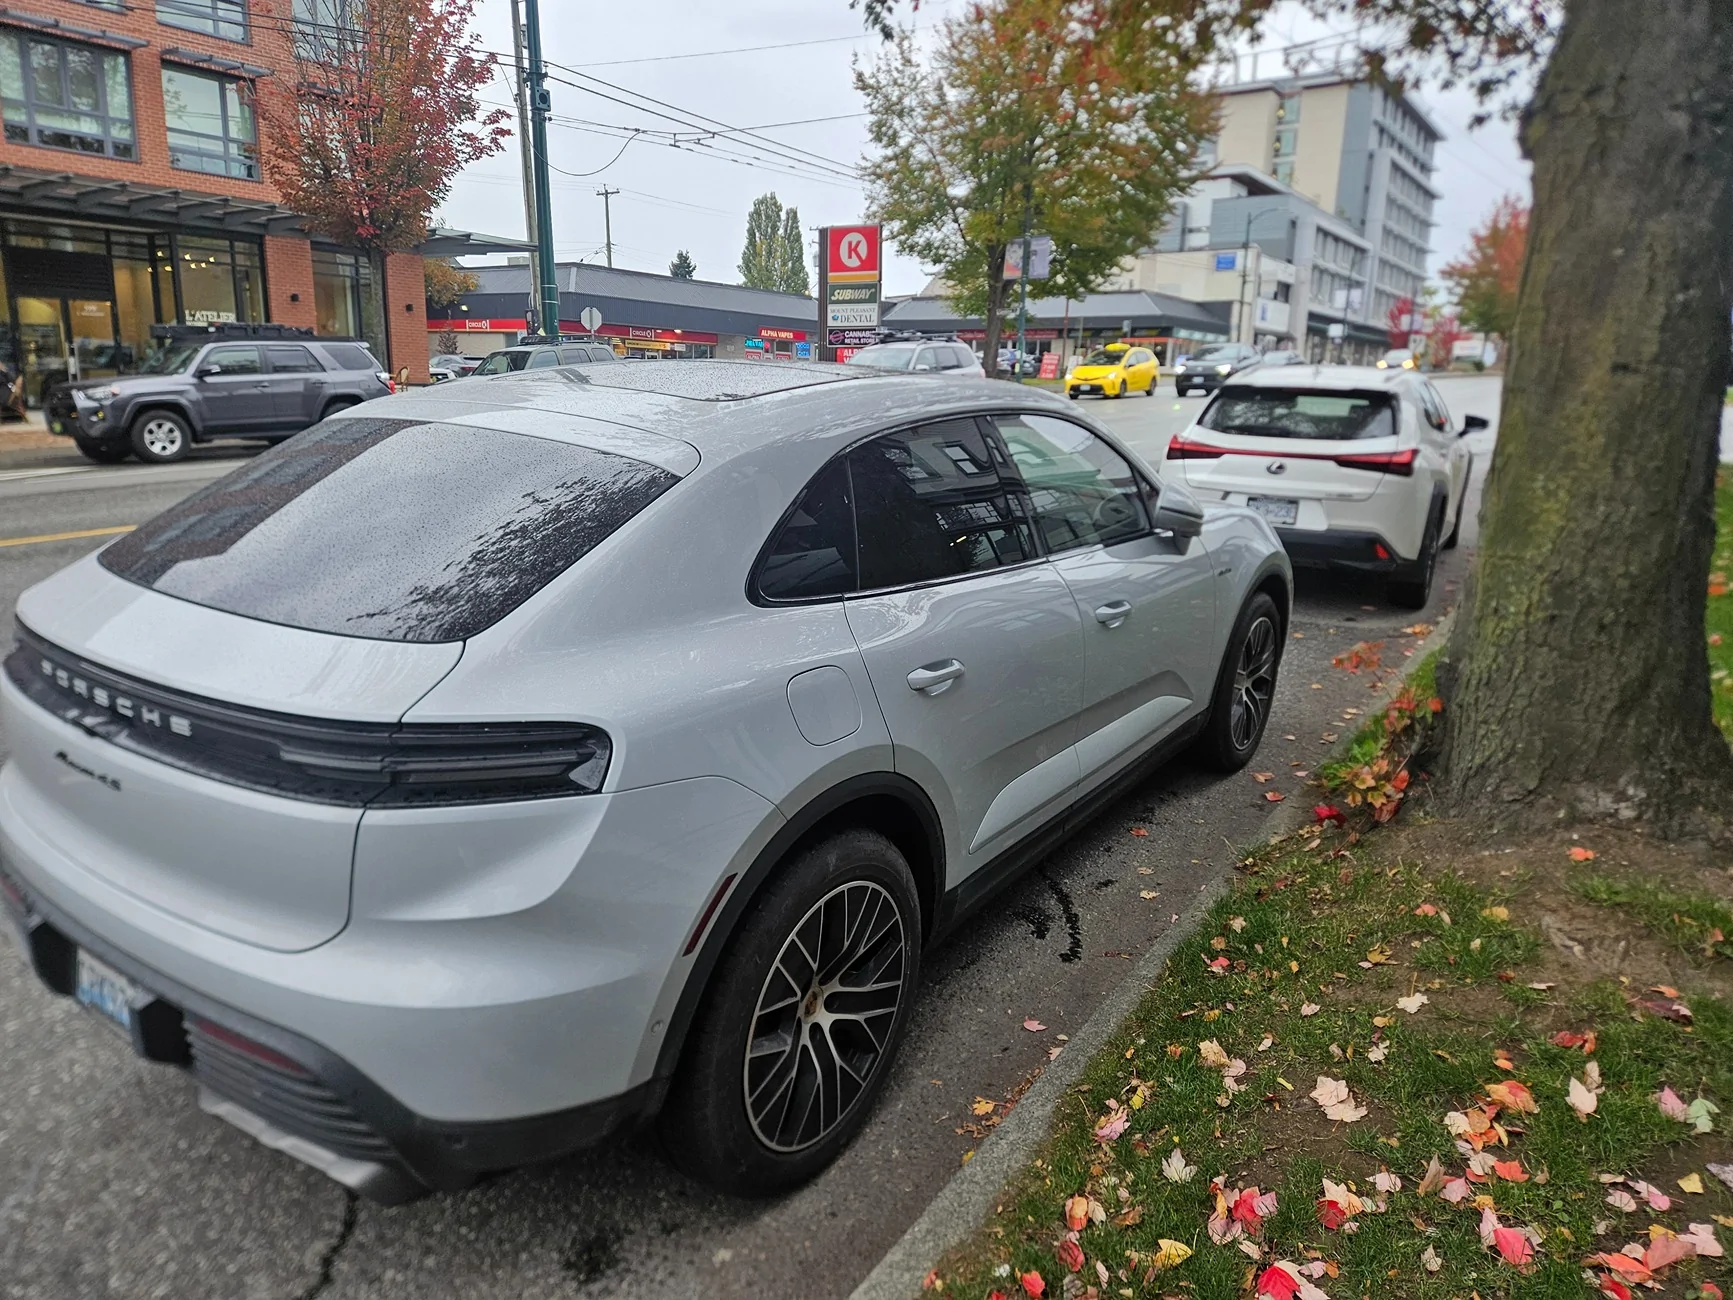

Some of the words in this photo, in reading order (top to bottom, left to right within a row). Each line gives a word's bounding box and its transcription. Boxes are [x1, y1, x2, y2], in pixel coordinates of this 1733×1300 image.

[830, 288, 873, 301] SUBWAY
[184, 309, 237, 323] L'ATELIER
[840, 314, 875, 323] DENTAL
[761, 329, 778, 338] ALPHA
[778, 331, 793, 339] VAPES
[40, 658, 193, 737] PORSCHE
